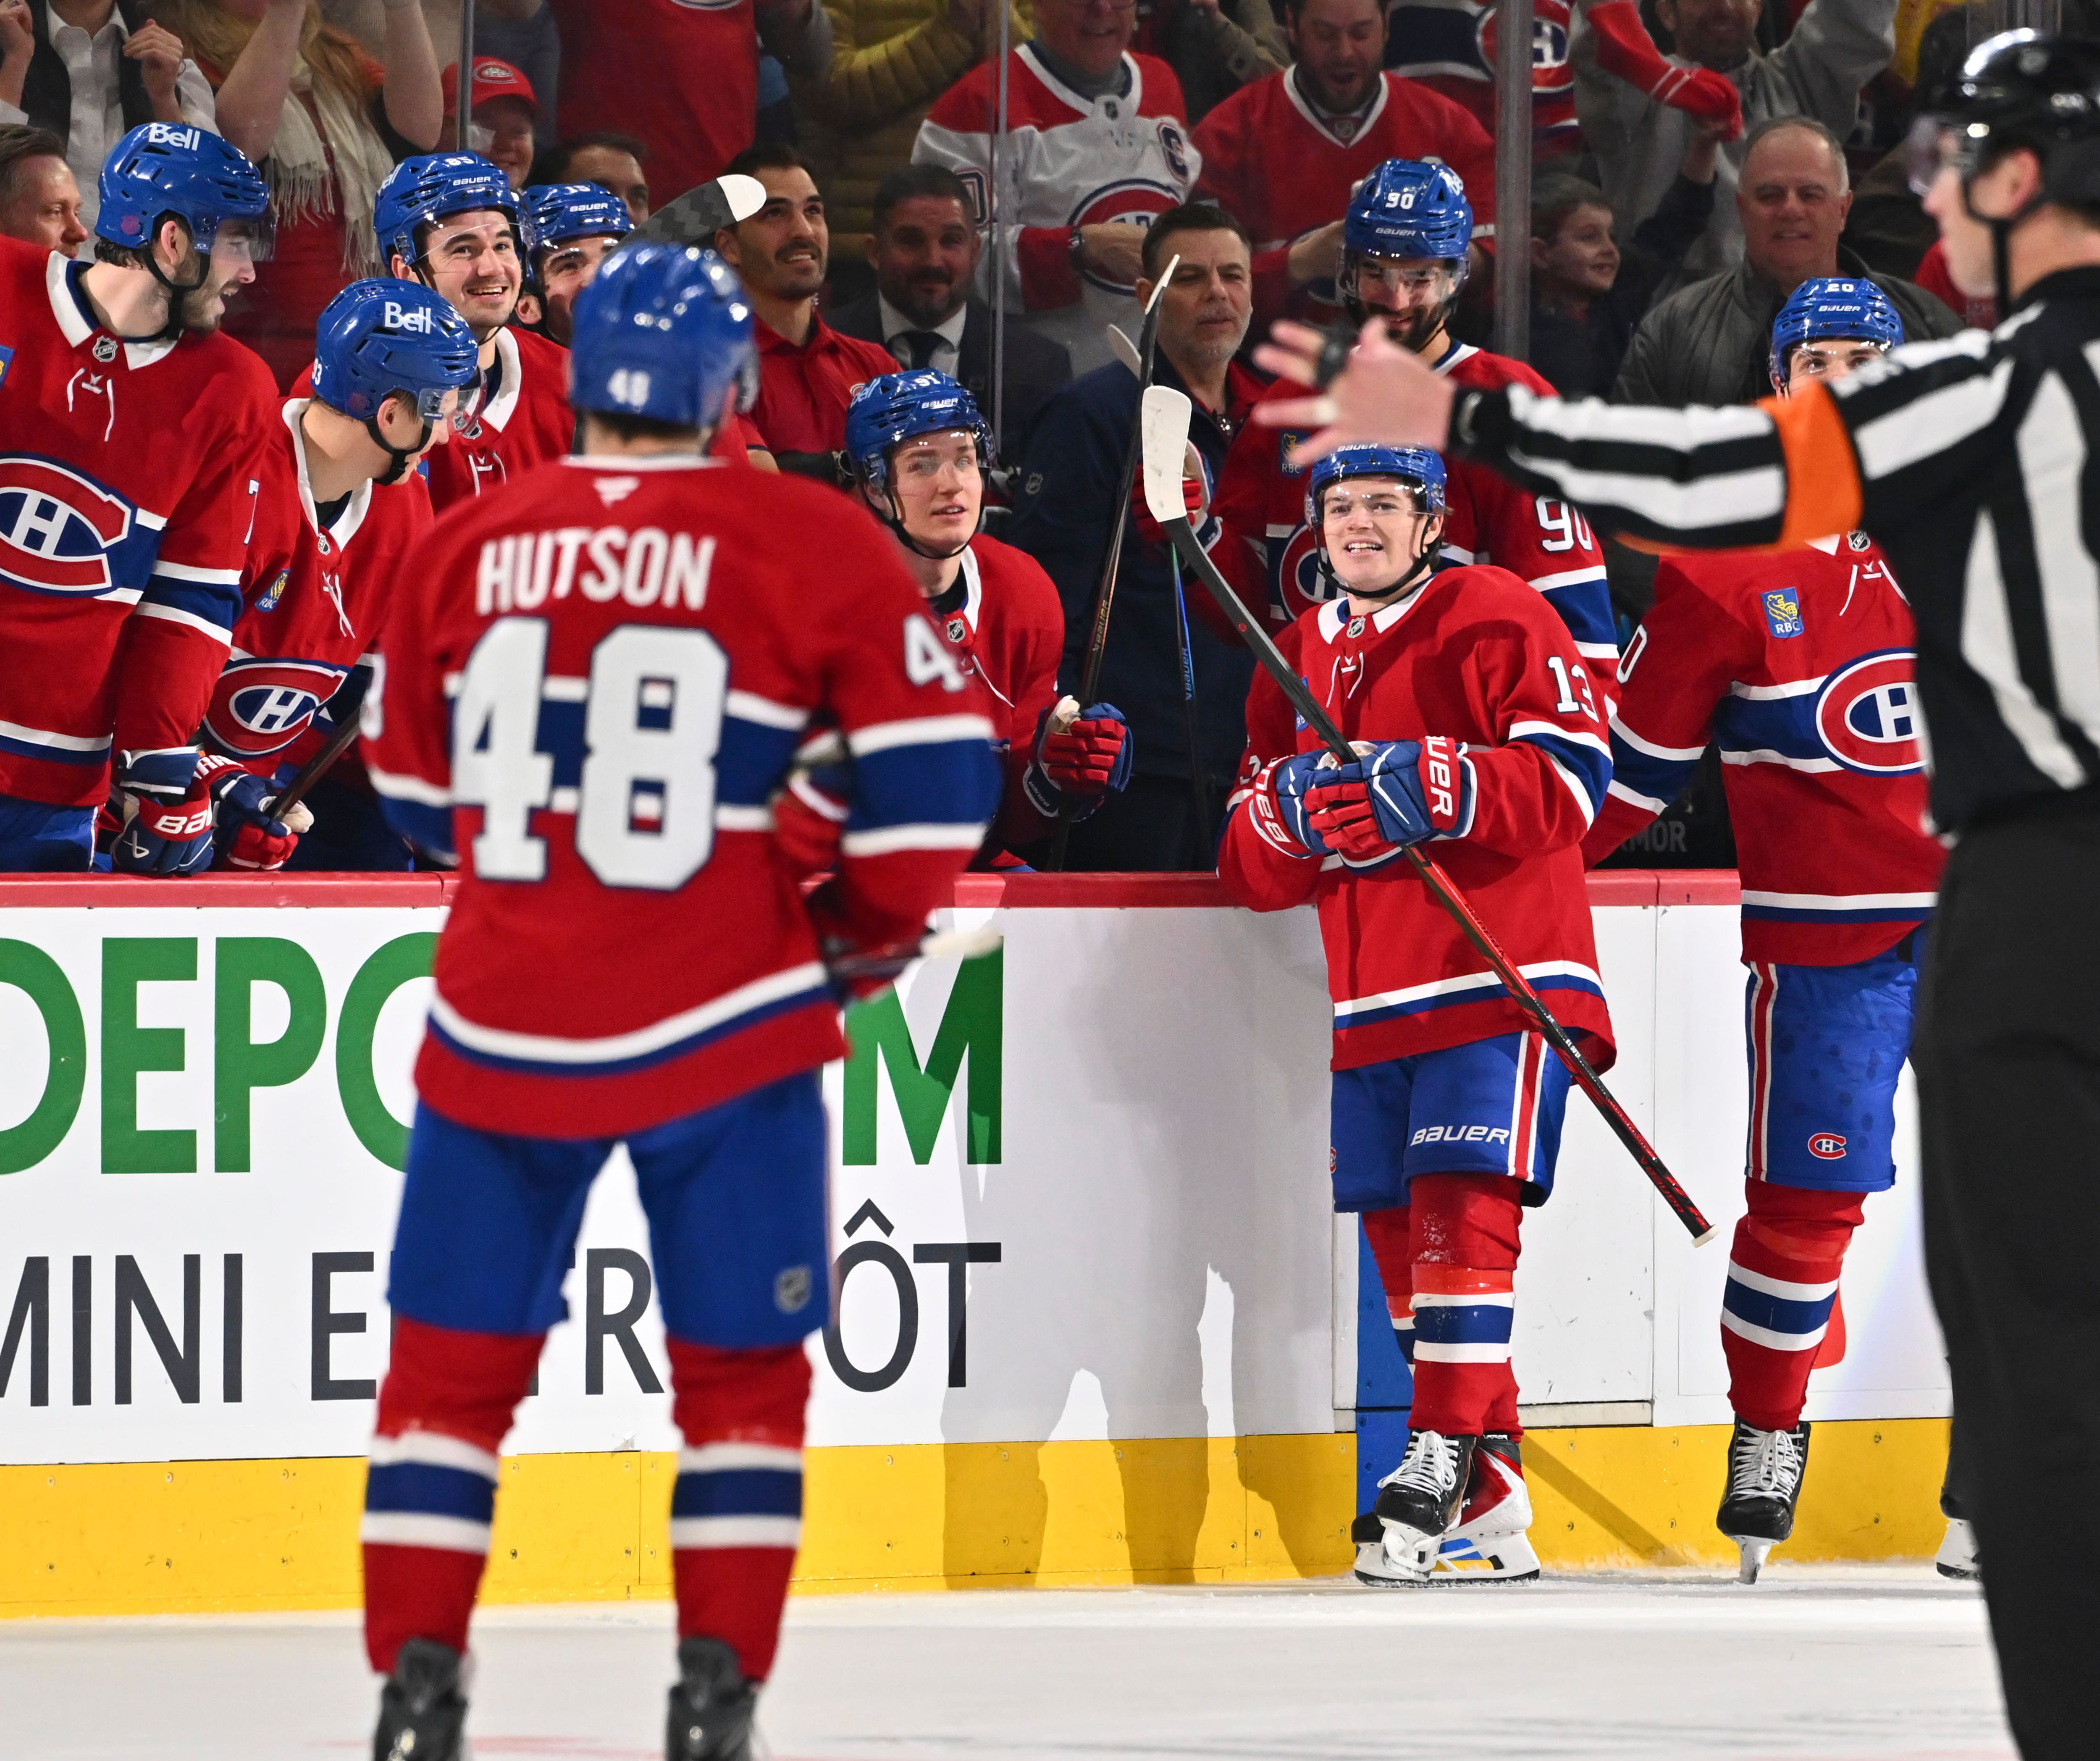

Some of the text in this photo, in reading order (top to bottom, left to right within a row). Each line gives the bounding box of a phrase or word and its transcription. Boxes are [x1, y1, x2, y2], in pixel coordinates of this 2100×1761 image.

[149, 123, 200, 151] Bell
[453, 176, 491, 186] BAUER
[1385, 192, 1415, 210] 90
[570, 203, 608, 212] BAUER
[1375, 227, 1416, 236] BAUER
[1827, 283, 1854, 292] 20
[385, 301, 431, 335] Bell
[921, 398, 959, 409] BAUER
[1337, 443, 1378, 452] BAUER
[1281, 463, 1301, 474] RBC
[476, 526, 717, 616] HUTSON
[258, 597, 278, 609] RBC
[1775, 621, 1801, 634] RBC
[1547, 655, 1599, 723] 13
[453, 617, 730, 890] 48
[1410, 1125, 1510, 1147] BAUER
